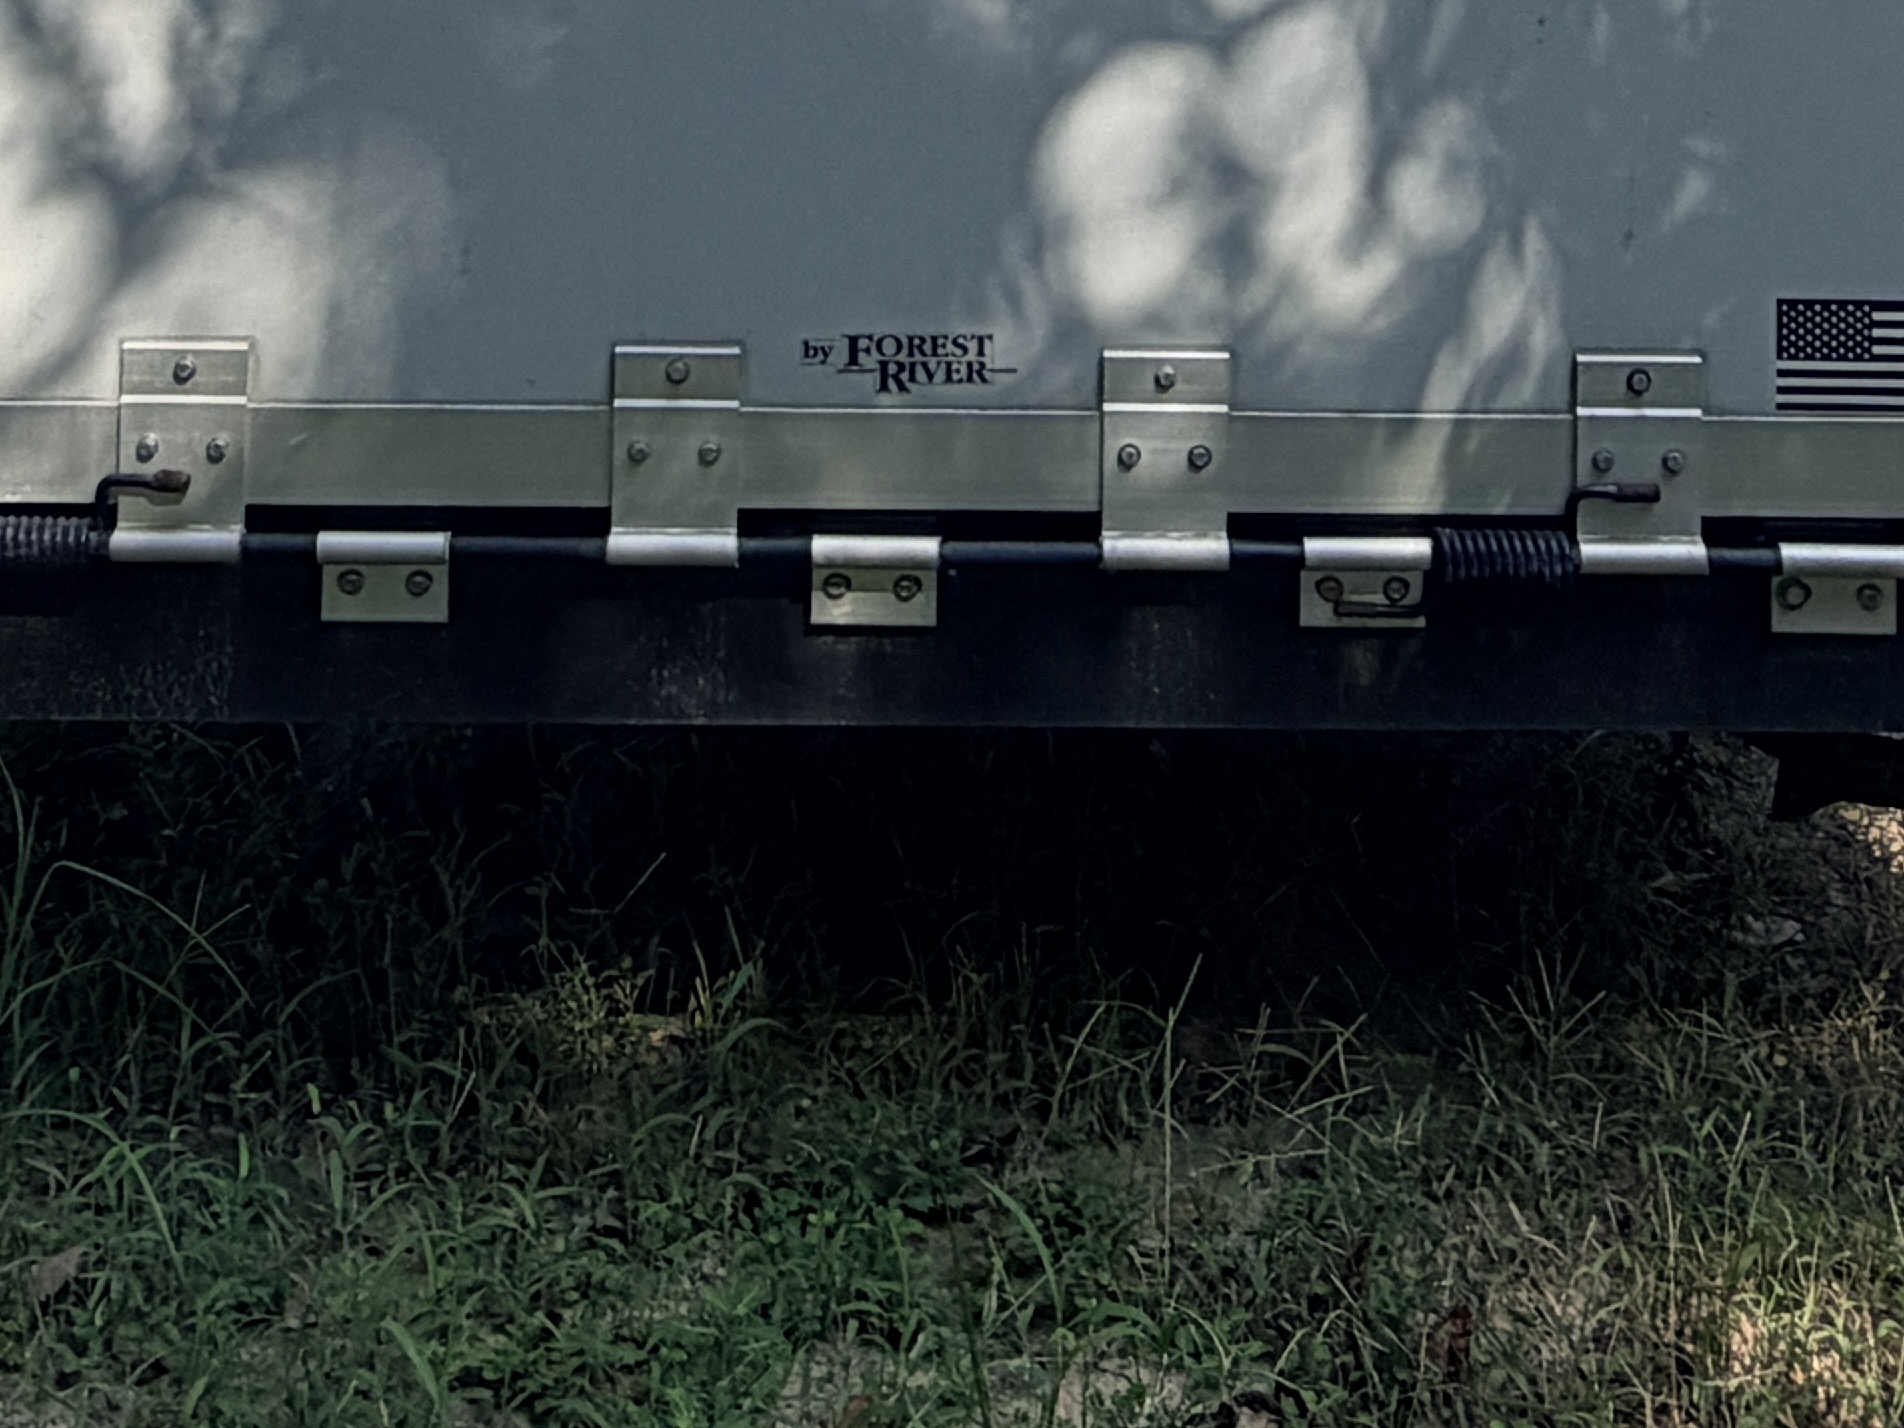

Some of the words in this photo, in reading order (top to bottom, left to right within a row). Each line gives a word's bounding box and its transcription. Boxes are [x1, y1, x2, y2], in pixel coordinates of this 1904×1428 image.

[802, 339, 834, 365] by
[841, 333, 994, 367] FOREST
[876, 360, 990, 394] RIVER
